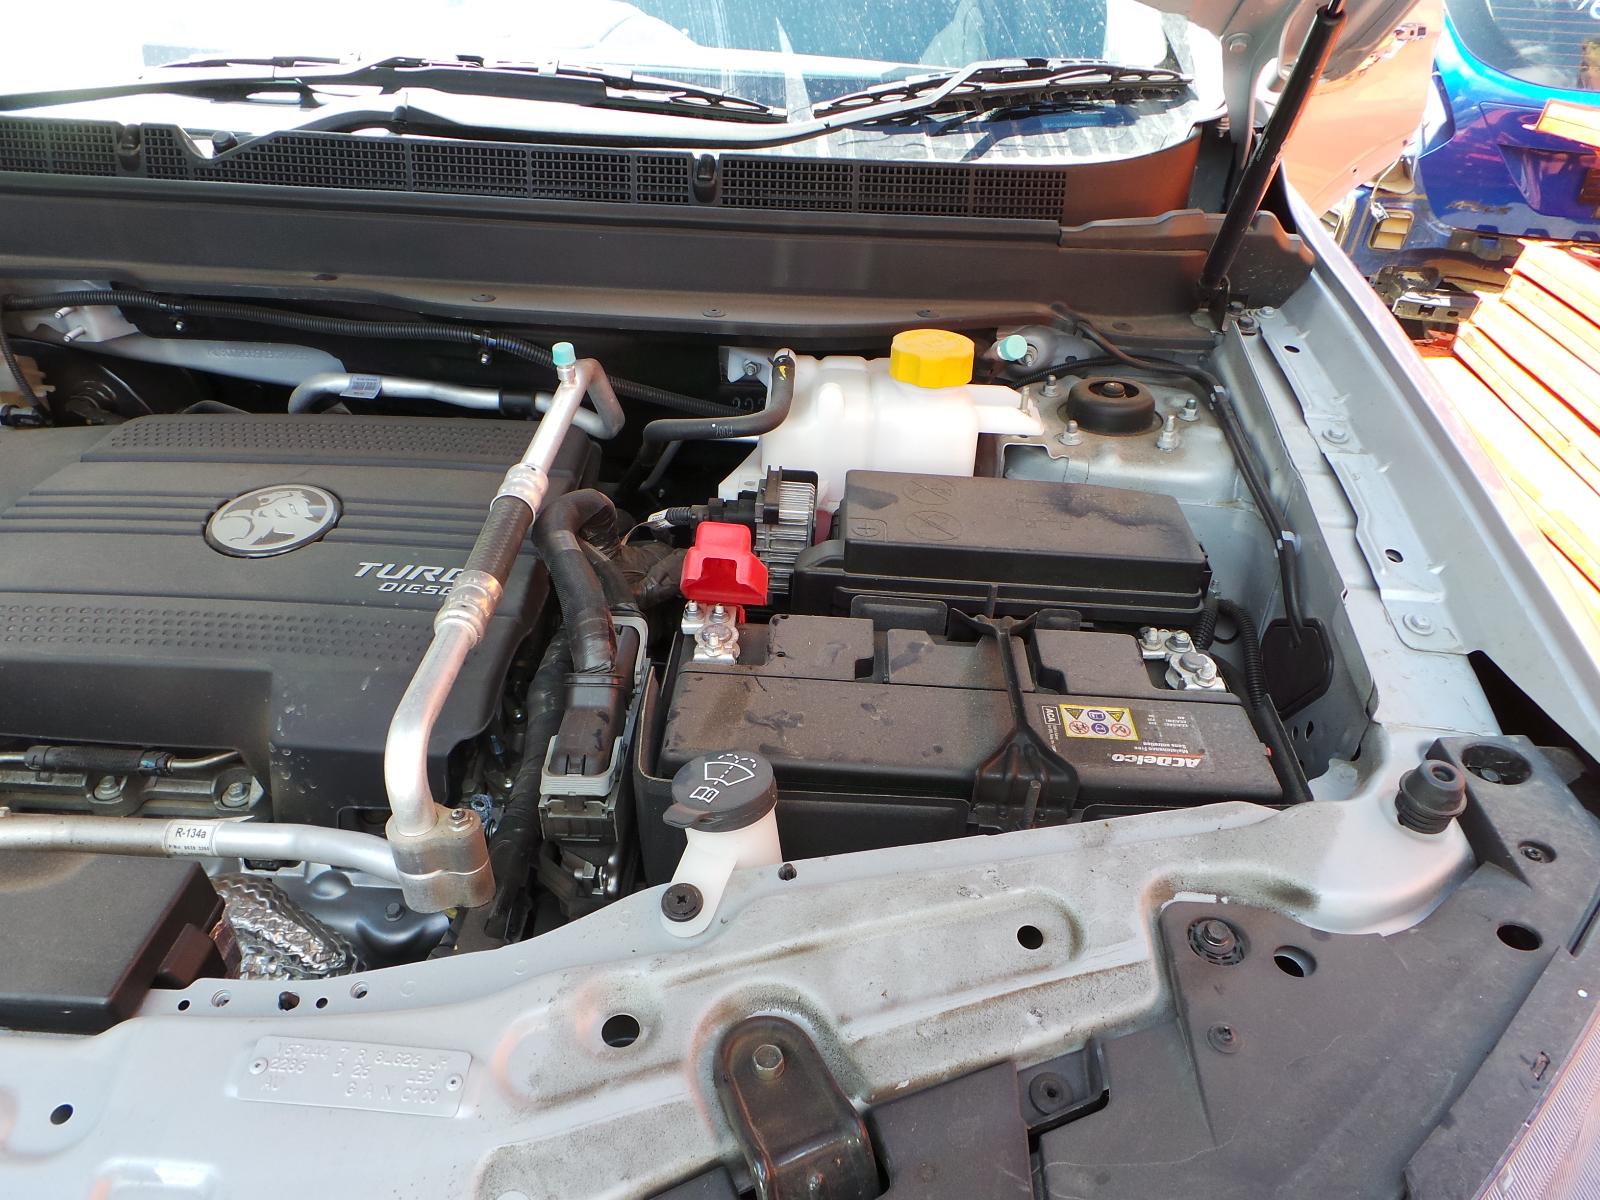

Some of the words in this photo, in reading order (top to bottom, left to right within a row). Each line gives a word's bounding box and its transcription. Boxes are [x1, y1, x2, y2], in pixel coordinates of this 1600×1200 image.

[378, 582, 453, 596] DIESE
[1111, 753, 1201, 768] ACDelco
[175, 828, 207, 839] R-134a
